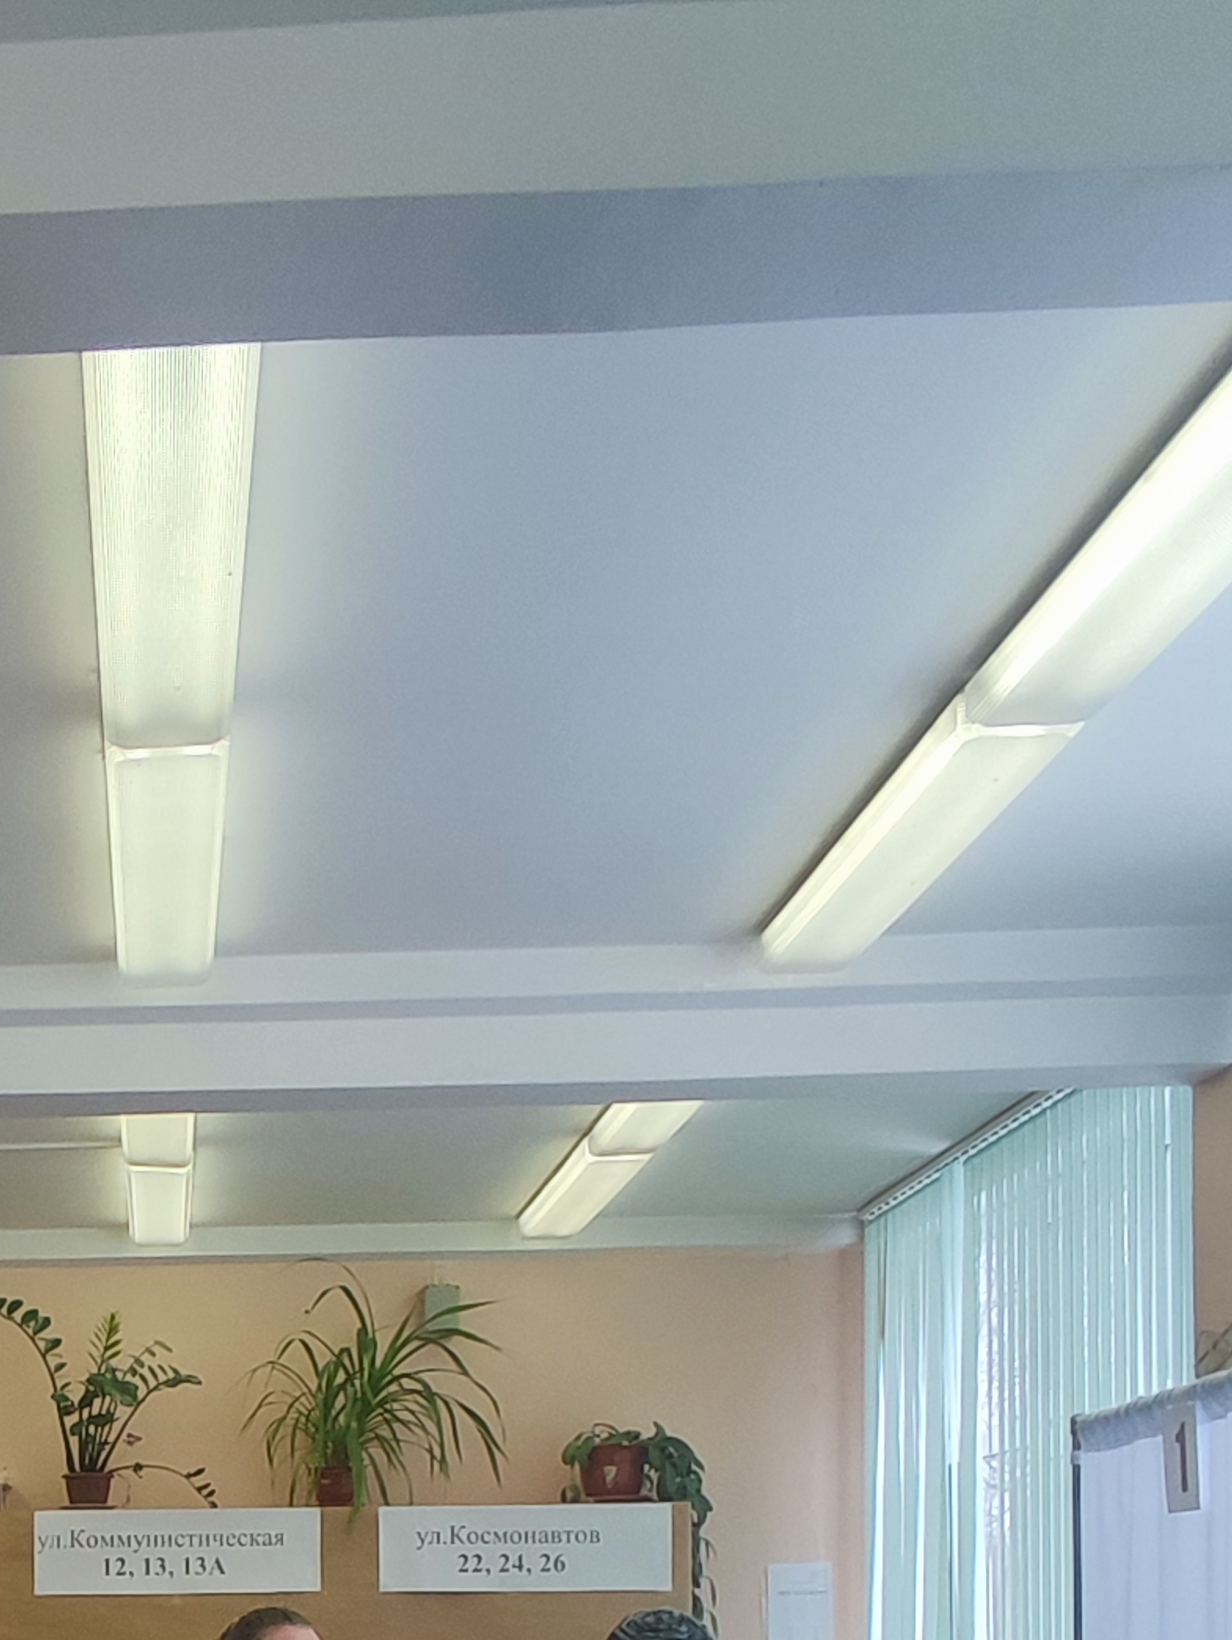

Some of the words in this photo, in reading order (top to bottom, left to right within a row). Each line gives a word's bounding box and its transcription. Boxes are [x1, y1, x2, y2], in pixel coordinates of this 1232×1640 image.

[1175, 1420, 1189, 1493] 1
[37, 1529, 285, 1554] ул.Коммунистическая
[416, 1525, 601, 1550] ул.Космонавтов
[103, 1556, 135, 1578] 12,
[143, 1556, 174, 1579] 13,
[183, 1556, 226, 1577] 13А
[457, 1553, 491, 1576] 22,
[498, 1553, 532, 1575] 24,
[539, 1553, 567, 1574] 26
